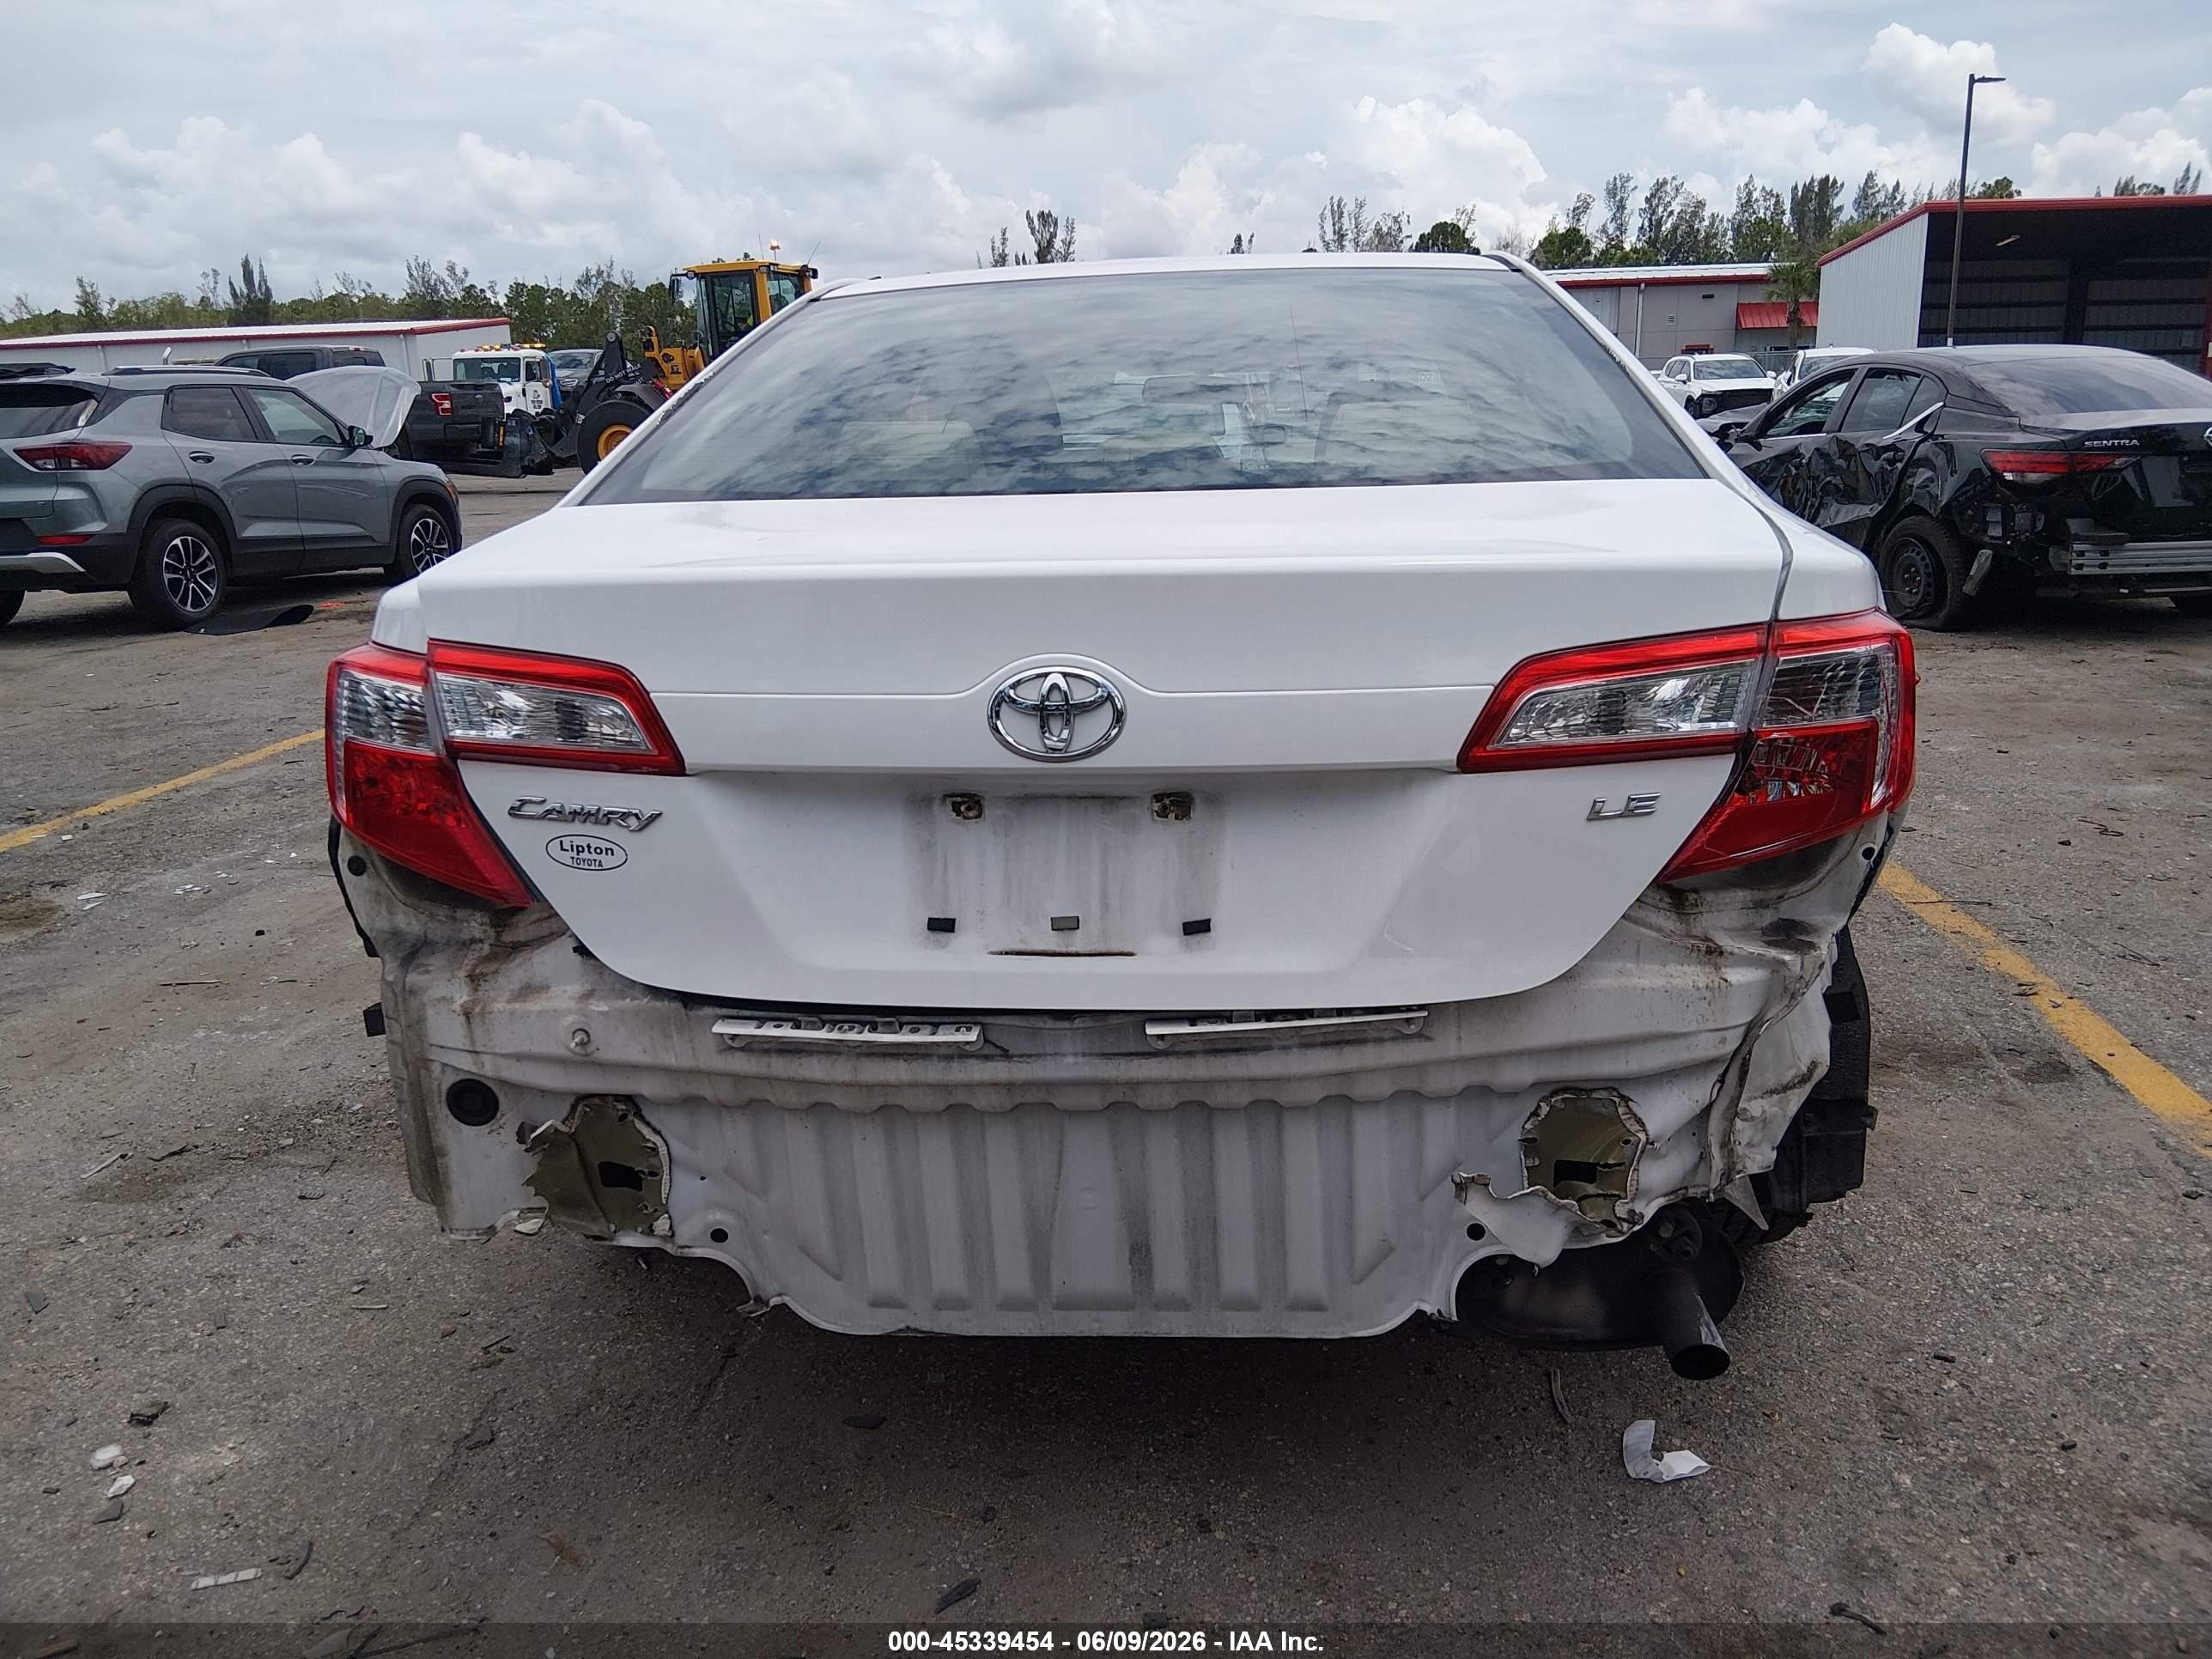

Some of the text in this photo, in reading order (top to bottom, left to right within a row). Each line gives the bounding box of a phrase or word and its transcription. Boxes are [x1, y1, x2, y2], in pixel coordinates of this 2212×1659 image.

[615, 370, 626, 379] NOT
[626, 362, 642, 373] WALK
[2084, 439, 2140, 448] SENTRA
[507, 795, 663, 832] CAMRY
[1586, 792, 1662, 821] LE
[559, 839, 615, 857] Lipton
[570, 856, 604, 868] TOYOTA
